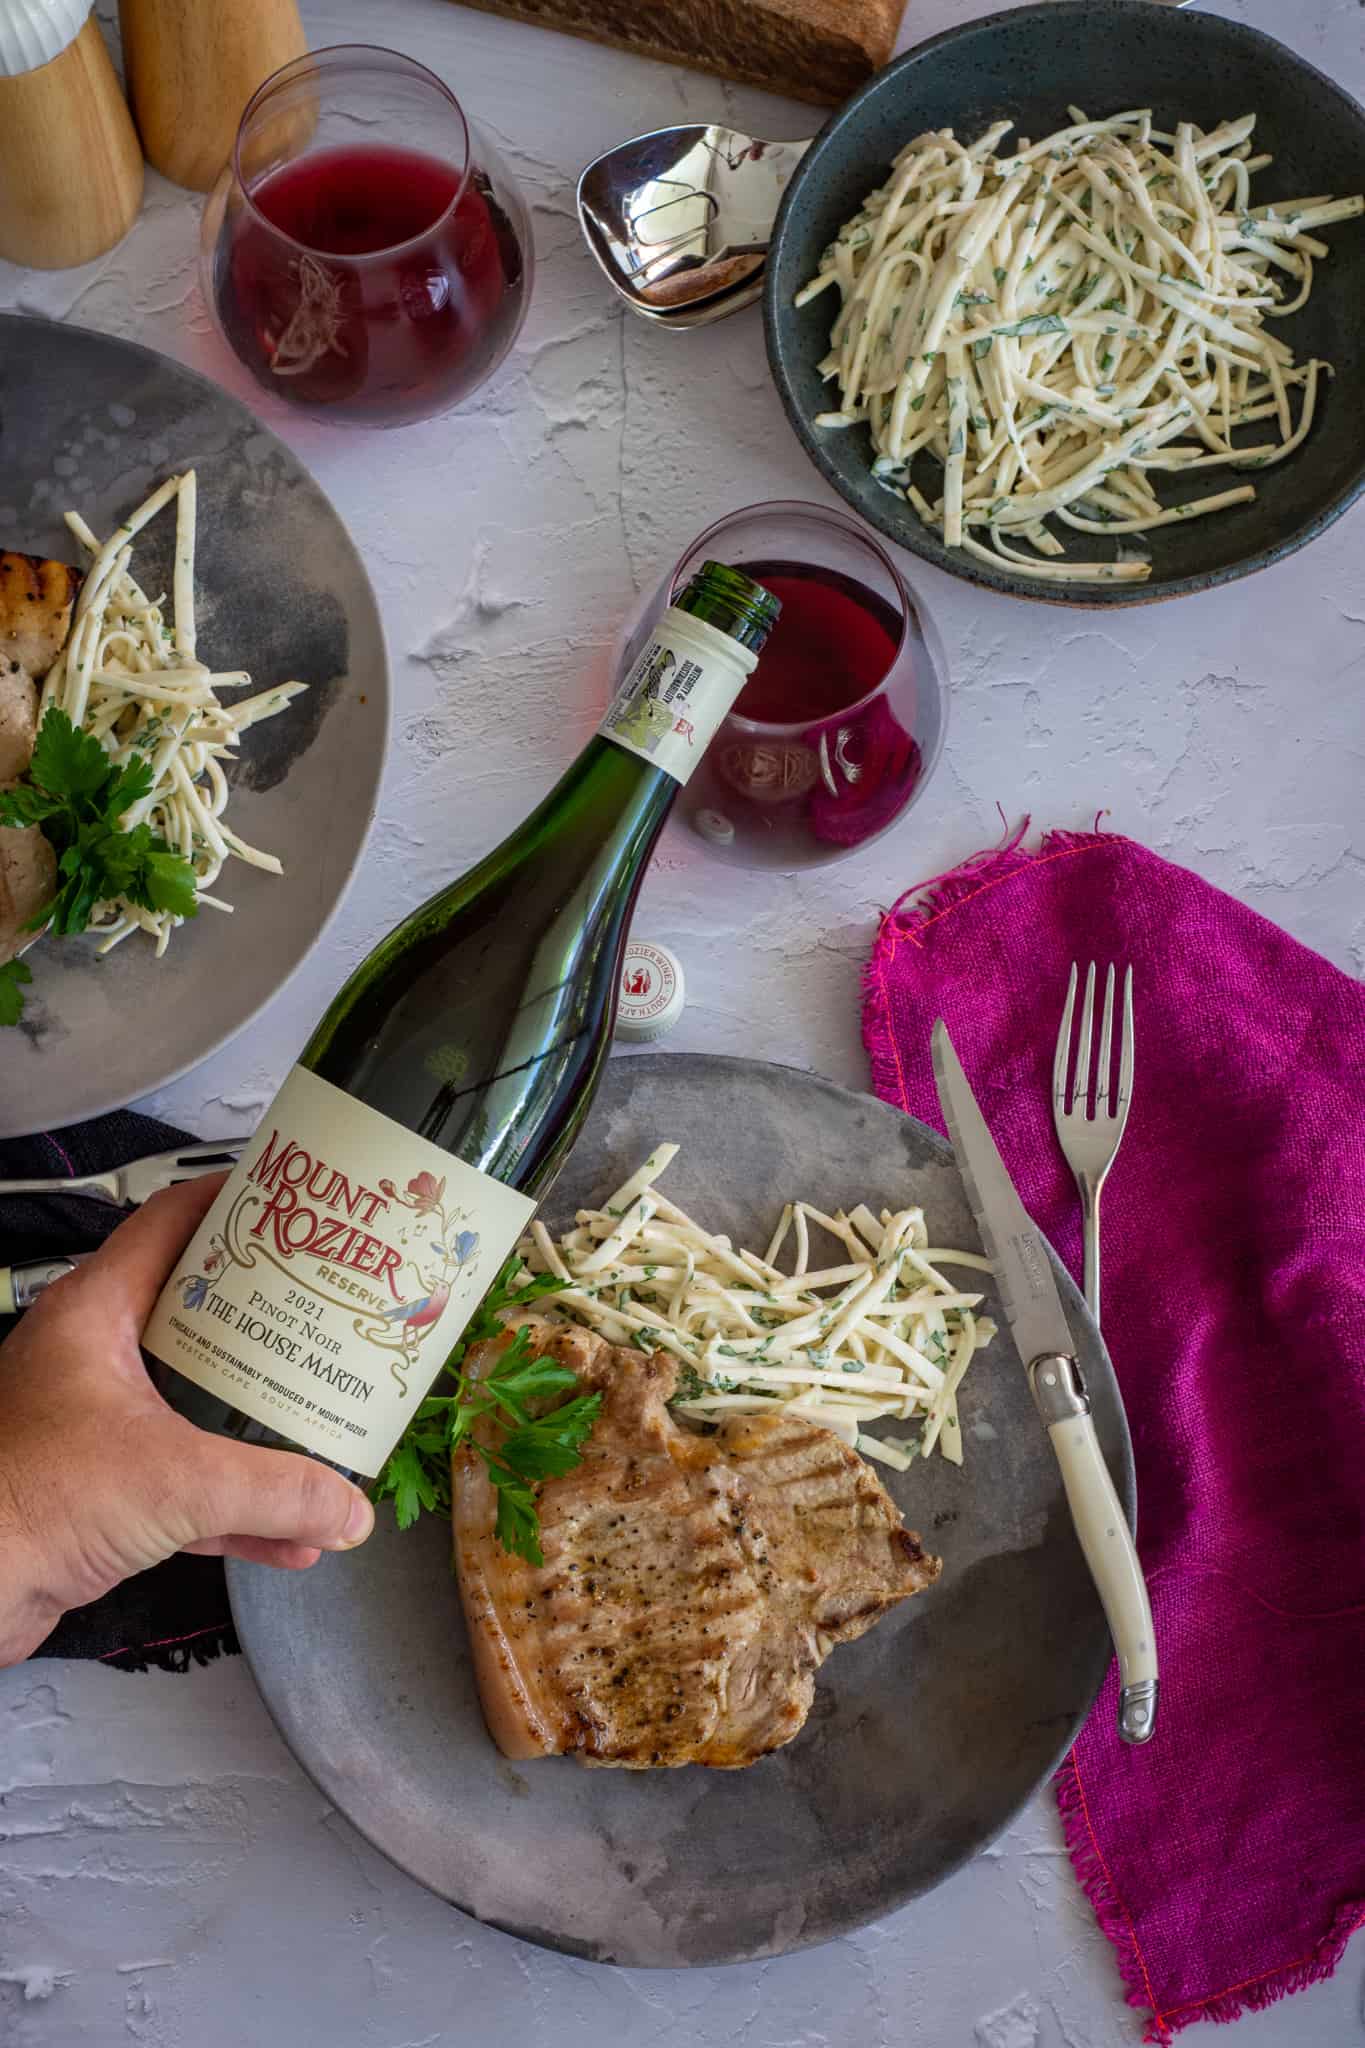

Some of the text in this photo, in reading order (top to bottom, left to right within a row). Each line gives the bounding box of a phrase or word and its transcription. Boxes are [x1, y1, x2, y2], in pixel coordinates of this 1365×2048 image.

[662, 660, 694, 704] SUSTAINABILITY
[681, 664, 704, 697] INTEGRITY
[625, 946, 657, 959] OZIER
[247, 1129, 390, 1227] MOUNT
[250, 1180, 408, 1304] ROZIER
[284, 1289, 326, 1322] 2021
[317, 1265, 388, 1312] RESERVE
[205, 1292, 375, 1403] THE HOUSE MARTIN
[196, 1335, 212, 1350] AND
[211, 1344, 263, 1380] SUSTAINABLY
[263, 1376, 305, 1405] PRODUCED
[305, 1400, 318, 1411] BY
[317, 1407, 345, 1426] MOUNT
[344, 1420, 368, 1437] ROZIER
